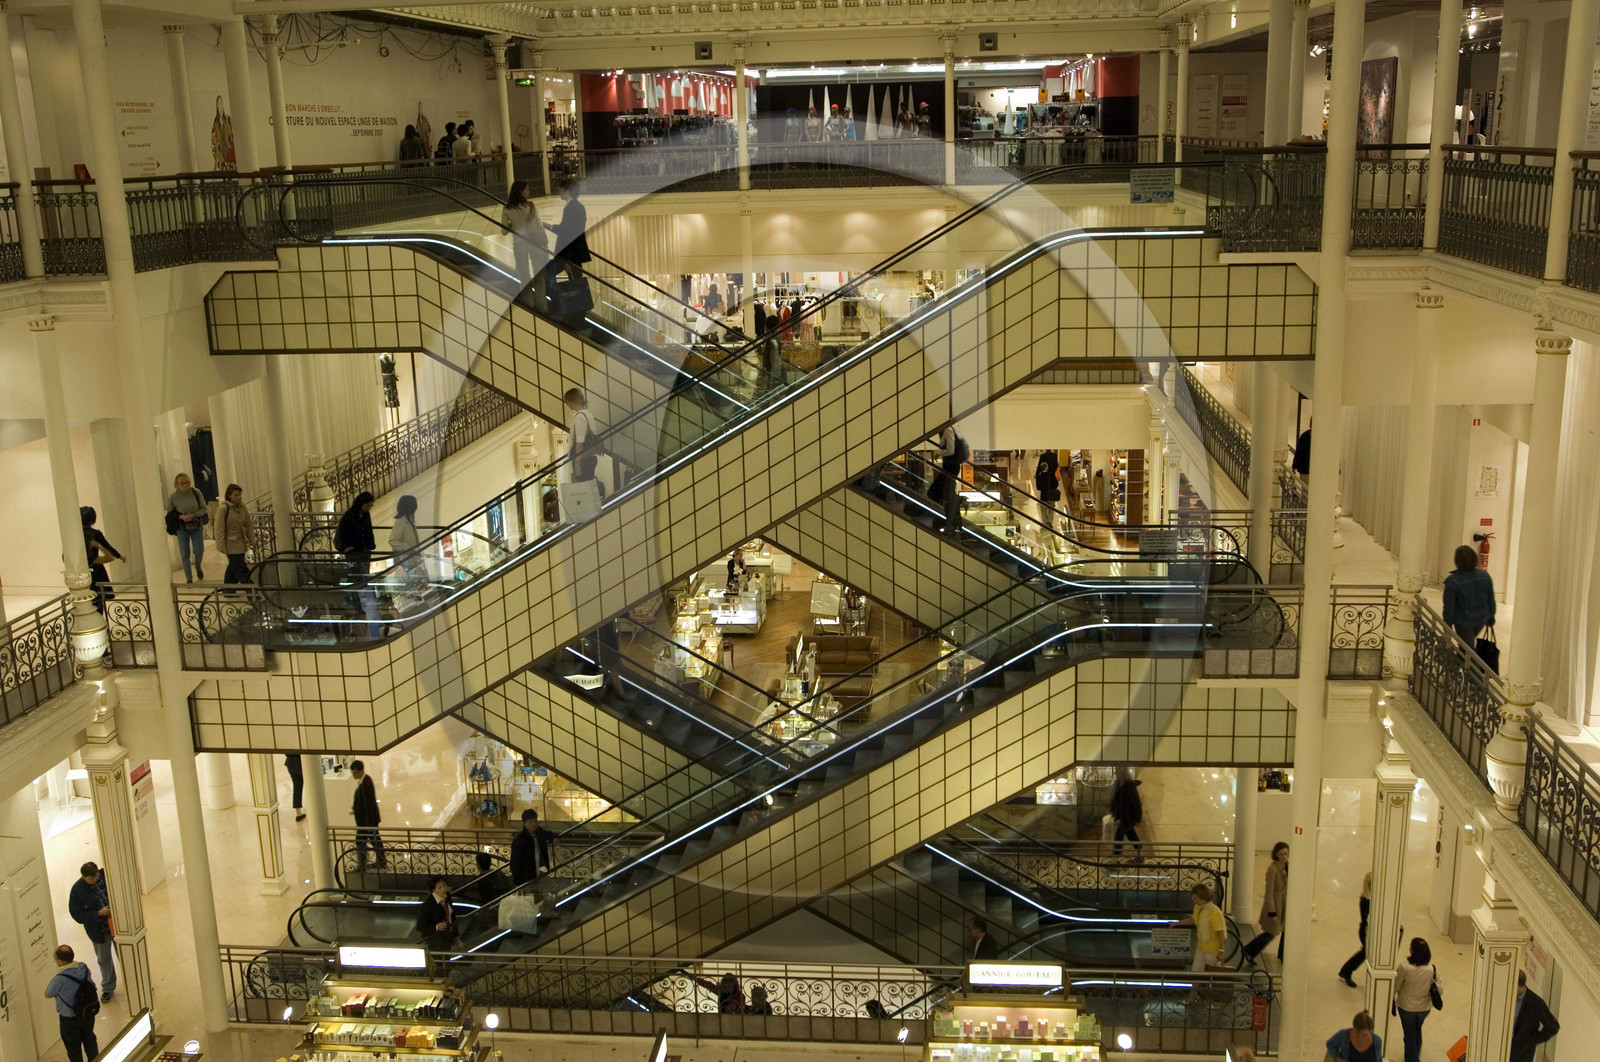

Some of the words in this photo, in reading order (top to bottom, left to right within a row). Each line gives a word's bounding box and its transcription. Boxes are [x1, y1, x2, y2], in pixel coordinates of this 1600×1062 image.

[1497, 94, 1503, 110] 2
[305, 117, 314, 126] DU
[315, 116, 337, 126] NOUVEL
[338, 116, 356, 126] ESPACE
[372, 117, 379, 126] DE
[379, 117, 398, 126] MAISON
[1498, 113, 1502, 128] 1
[1494, 130, 1499, 145] 0
[0, 991, 8, 1009] 0
[1, 1006, 9, 1022] -1
